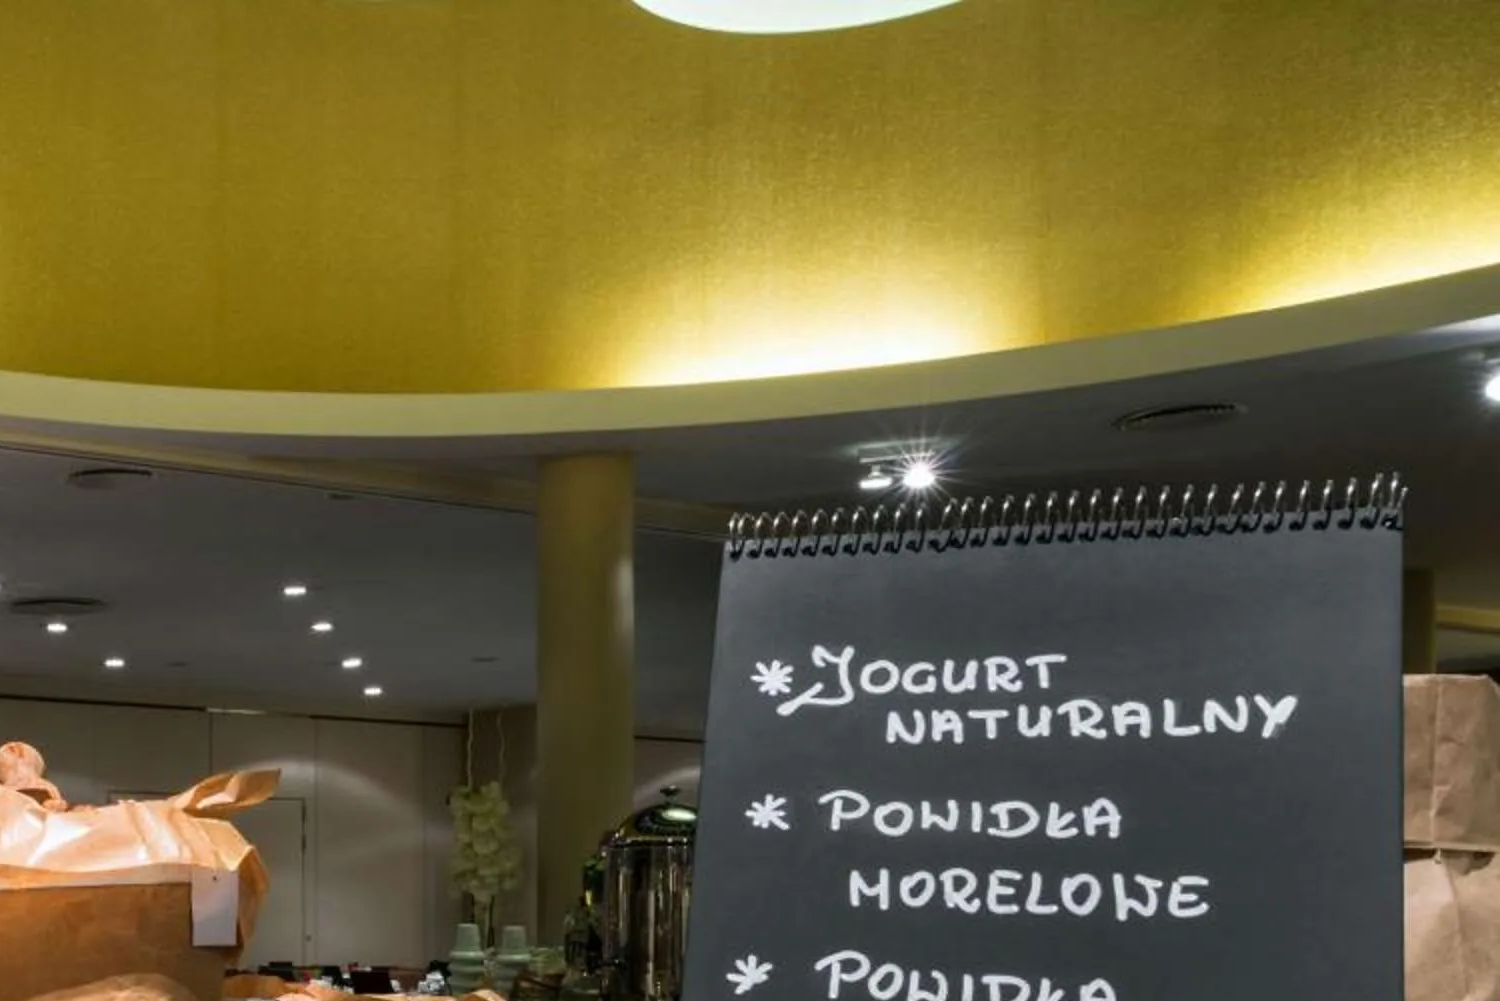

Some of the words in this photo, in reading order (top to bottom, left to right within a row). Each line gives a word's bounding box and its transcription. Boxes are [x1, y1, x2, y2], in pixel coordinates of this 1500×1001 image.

[776, 645, 1067, 717] JOGURT
[885, 693, 1299, 745] NATURALNY
[817, 789, 1122, 839] POWIDŁA
[849, 867, 1210, 922] MORELOWE
